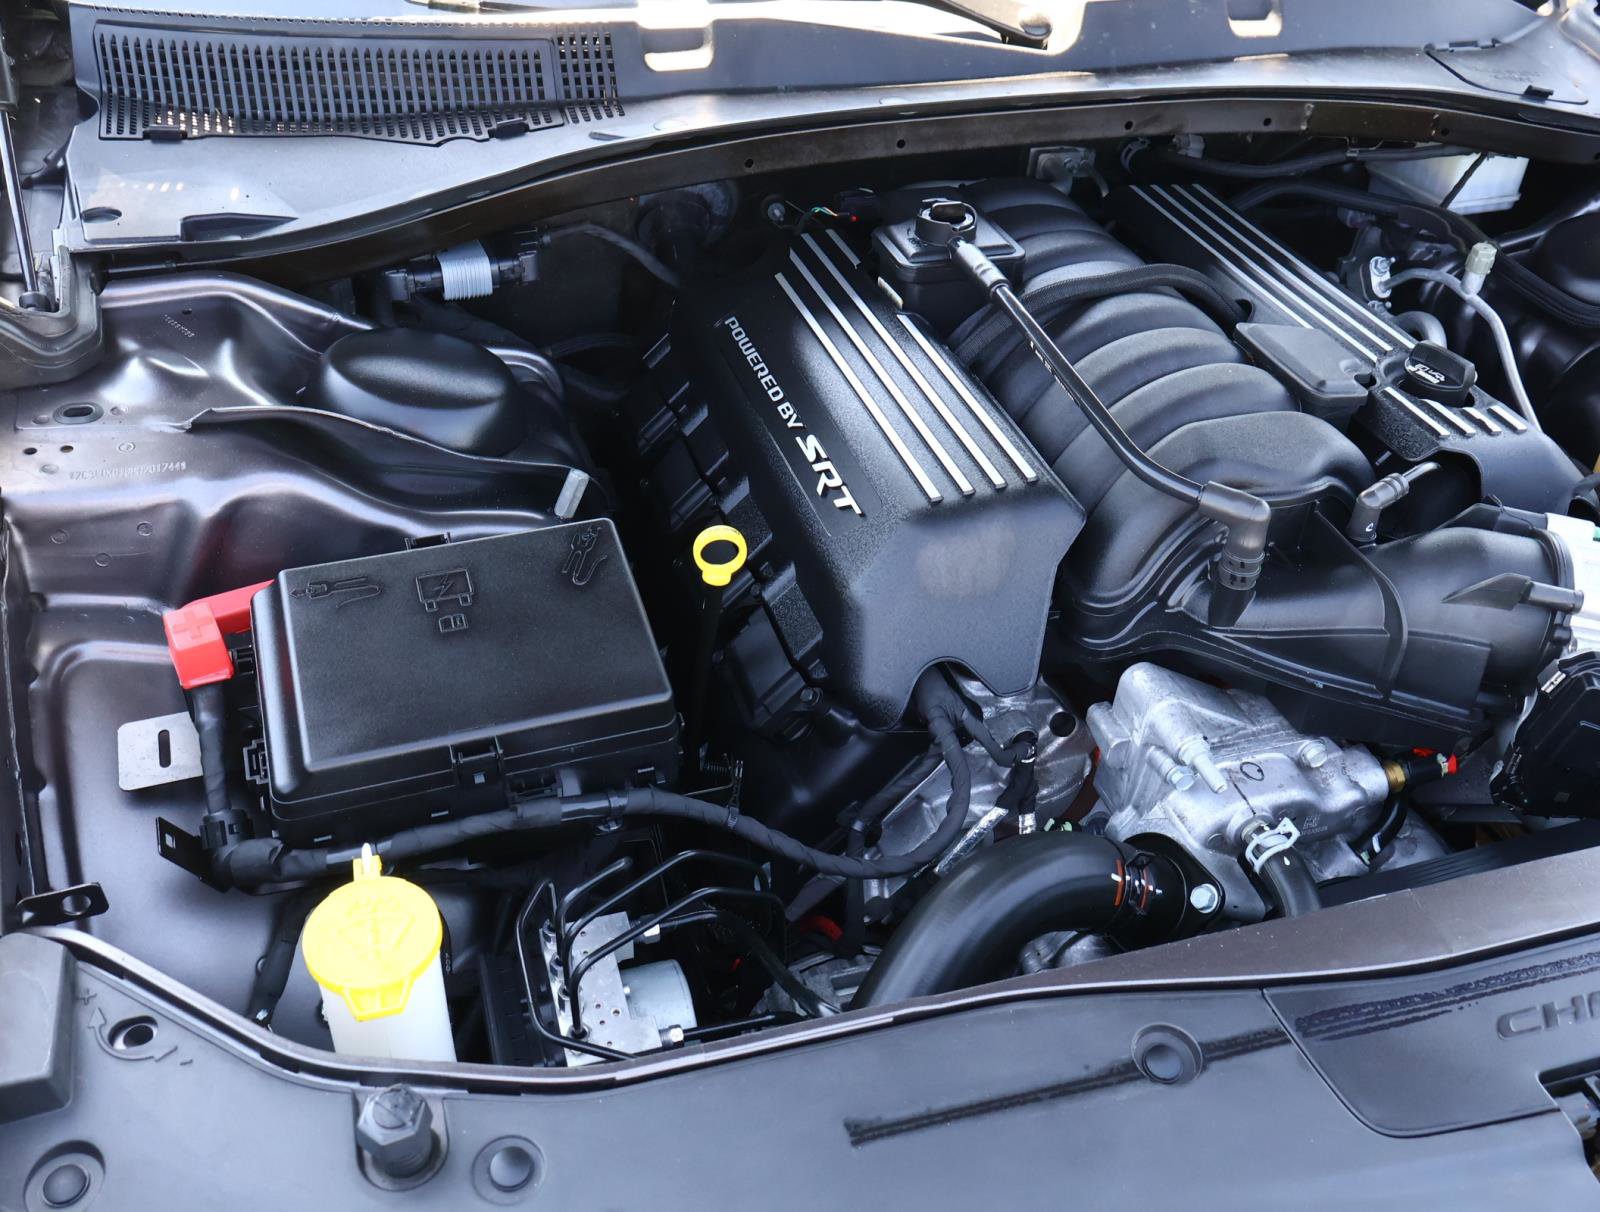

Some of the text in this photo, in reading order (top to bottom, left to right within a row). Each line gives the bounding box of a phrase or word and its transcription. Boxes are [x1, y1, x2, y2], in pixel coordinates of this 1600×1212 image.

[725, 316, 863, 515] POWERED BY SRT
